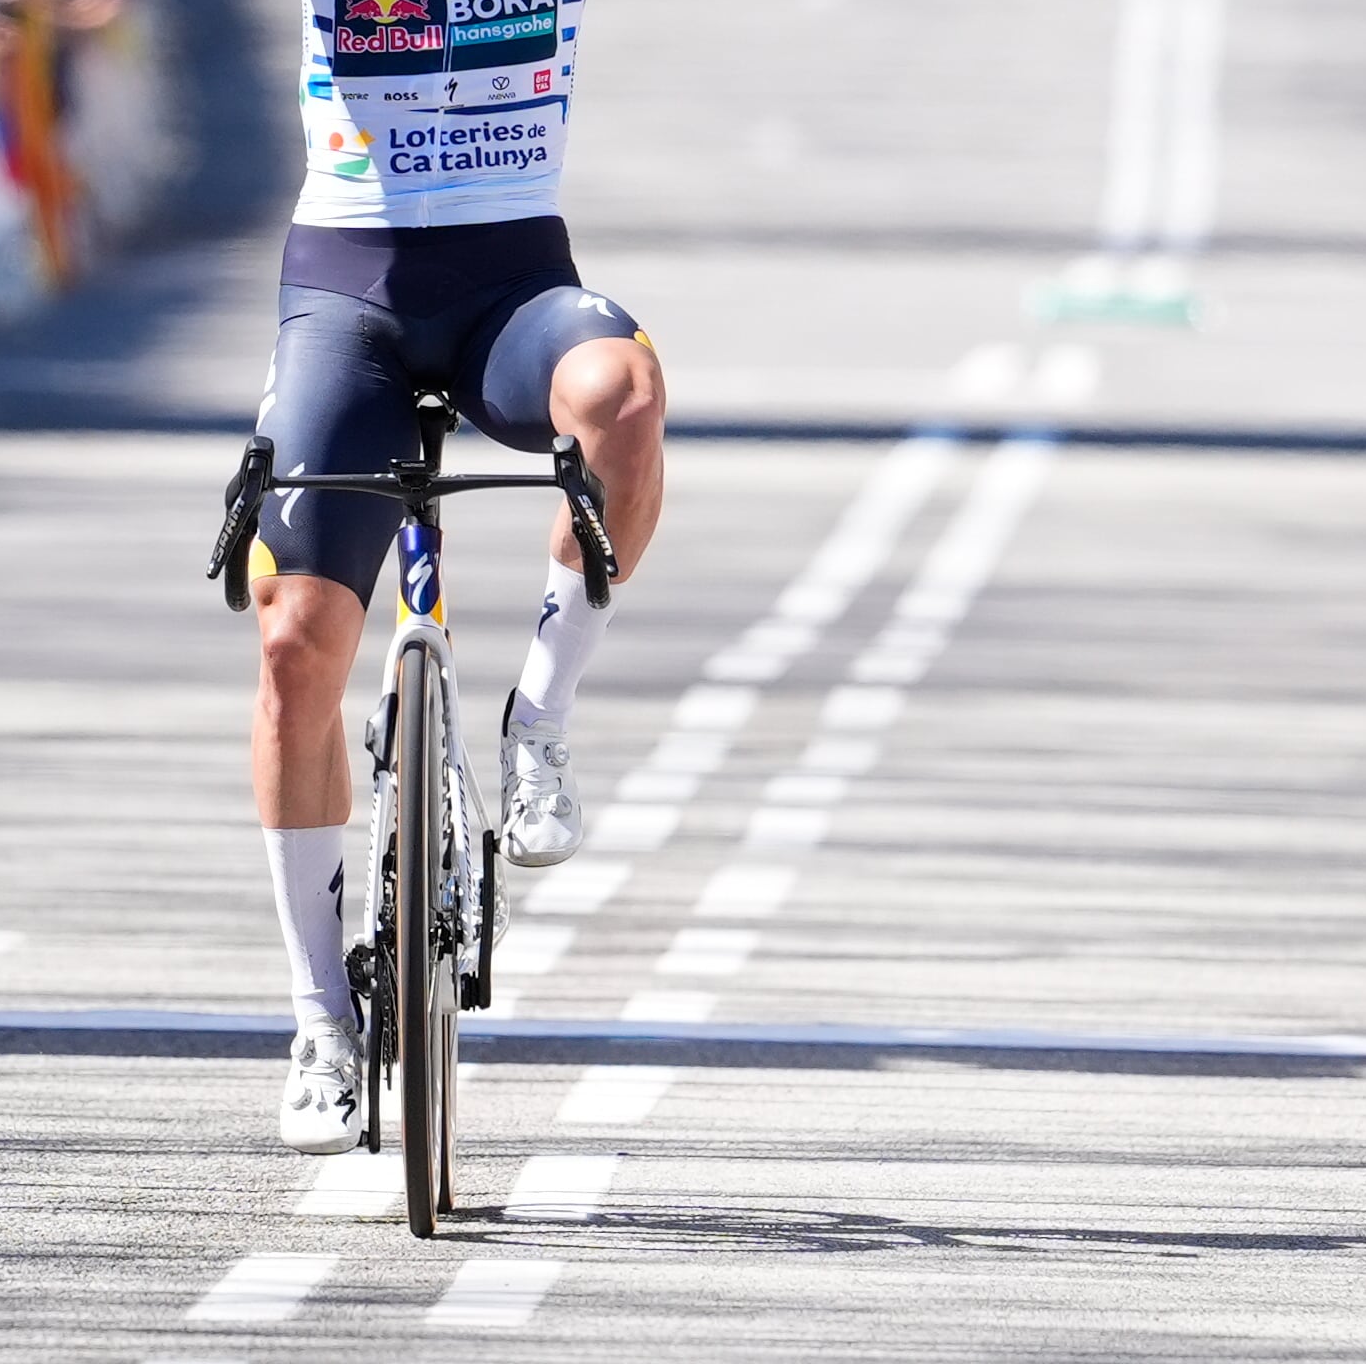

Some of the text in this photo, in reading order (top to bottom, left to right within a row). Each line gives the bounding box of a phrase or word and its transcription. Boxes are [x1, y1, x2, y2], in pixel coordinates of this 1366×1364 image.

[337, 24, 444, 53] Red Bull
[453, 13, 554, 42] hansgrohe
[383, 92, 419, 101] BOSS
[389, 121, 547, 149] Loteries de
[389, 145, 547, 174] Catalunya
[213, 495, 246, 563] SRAM
